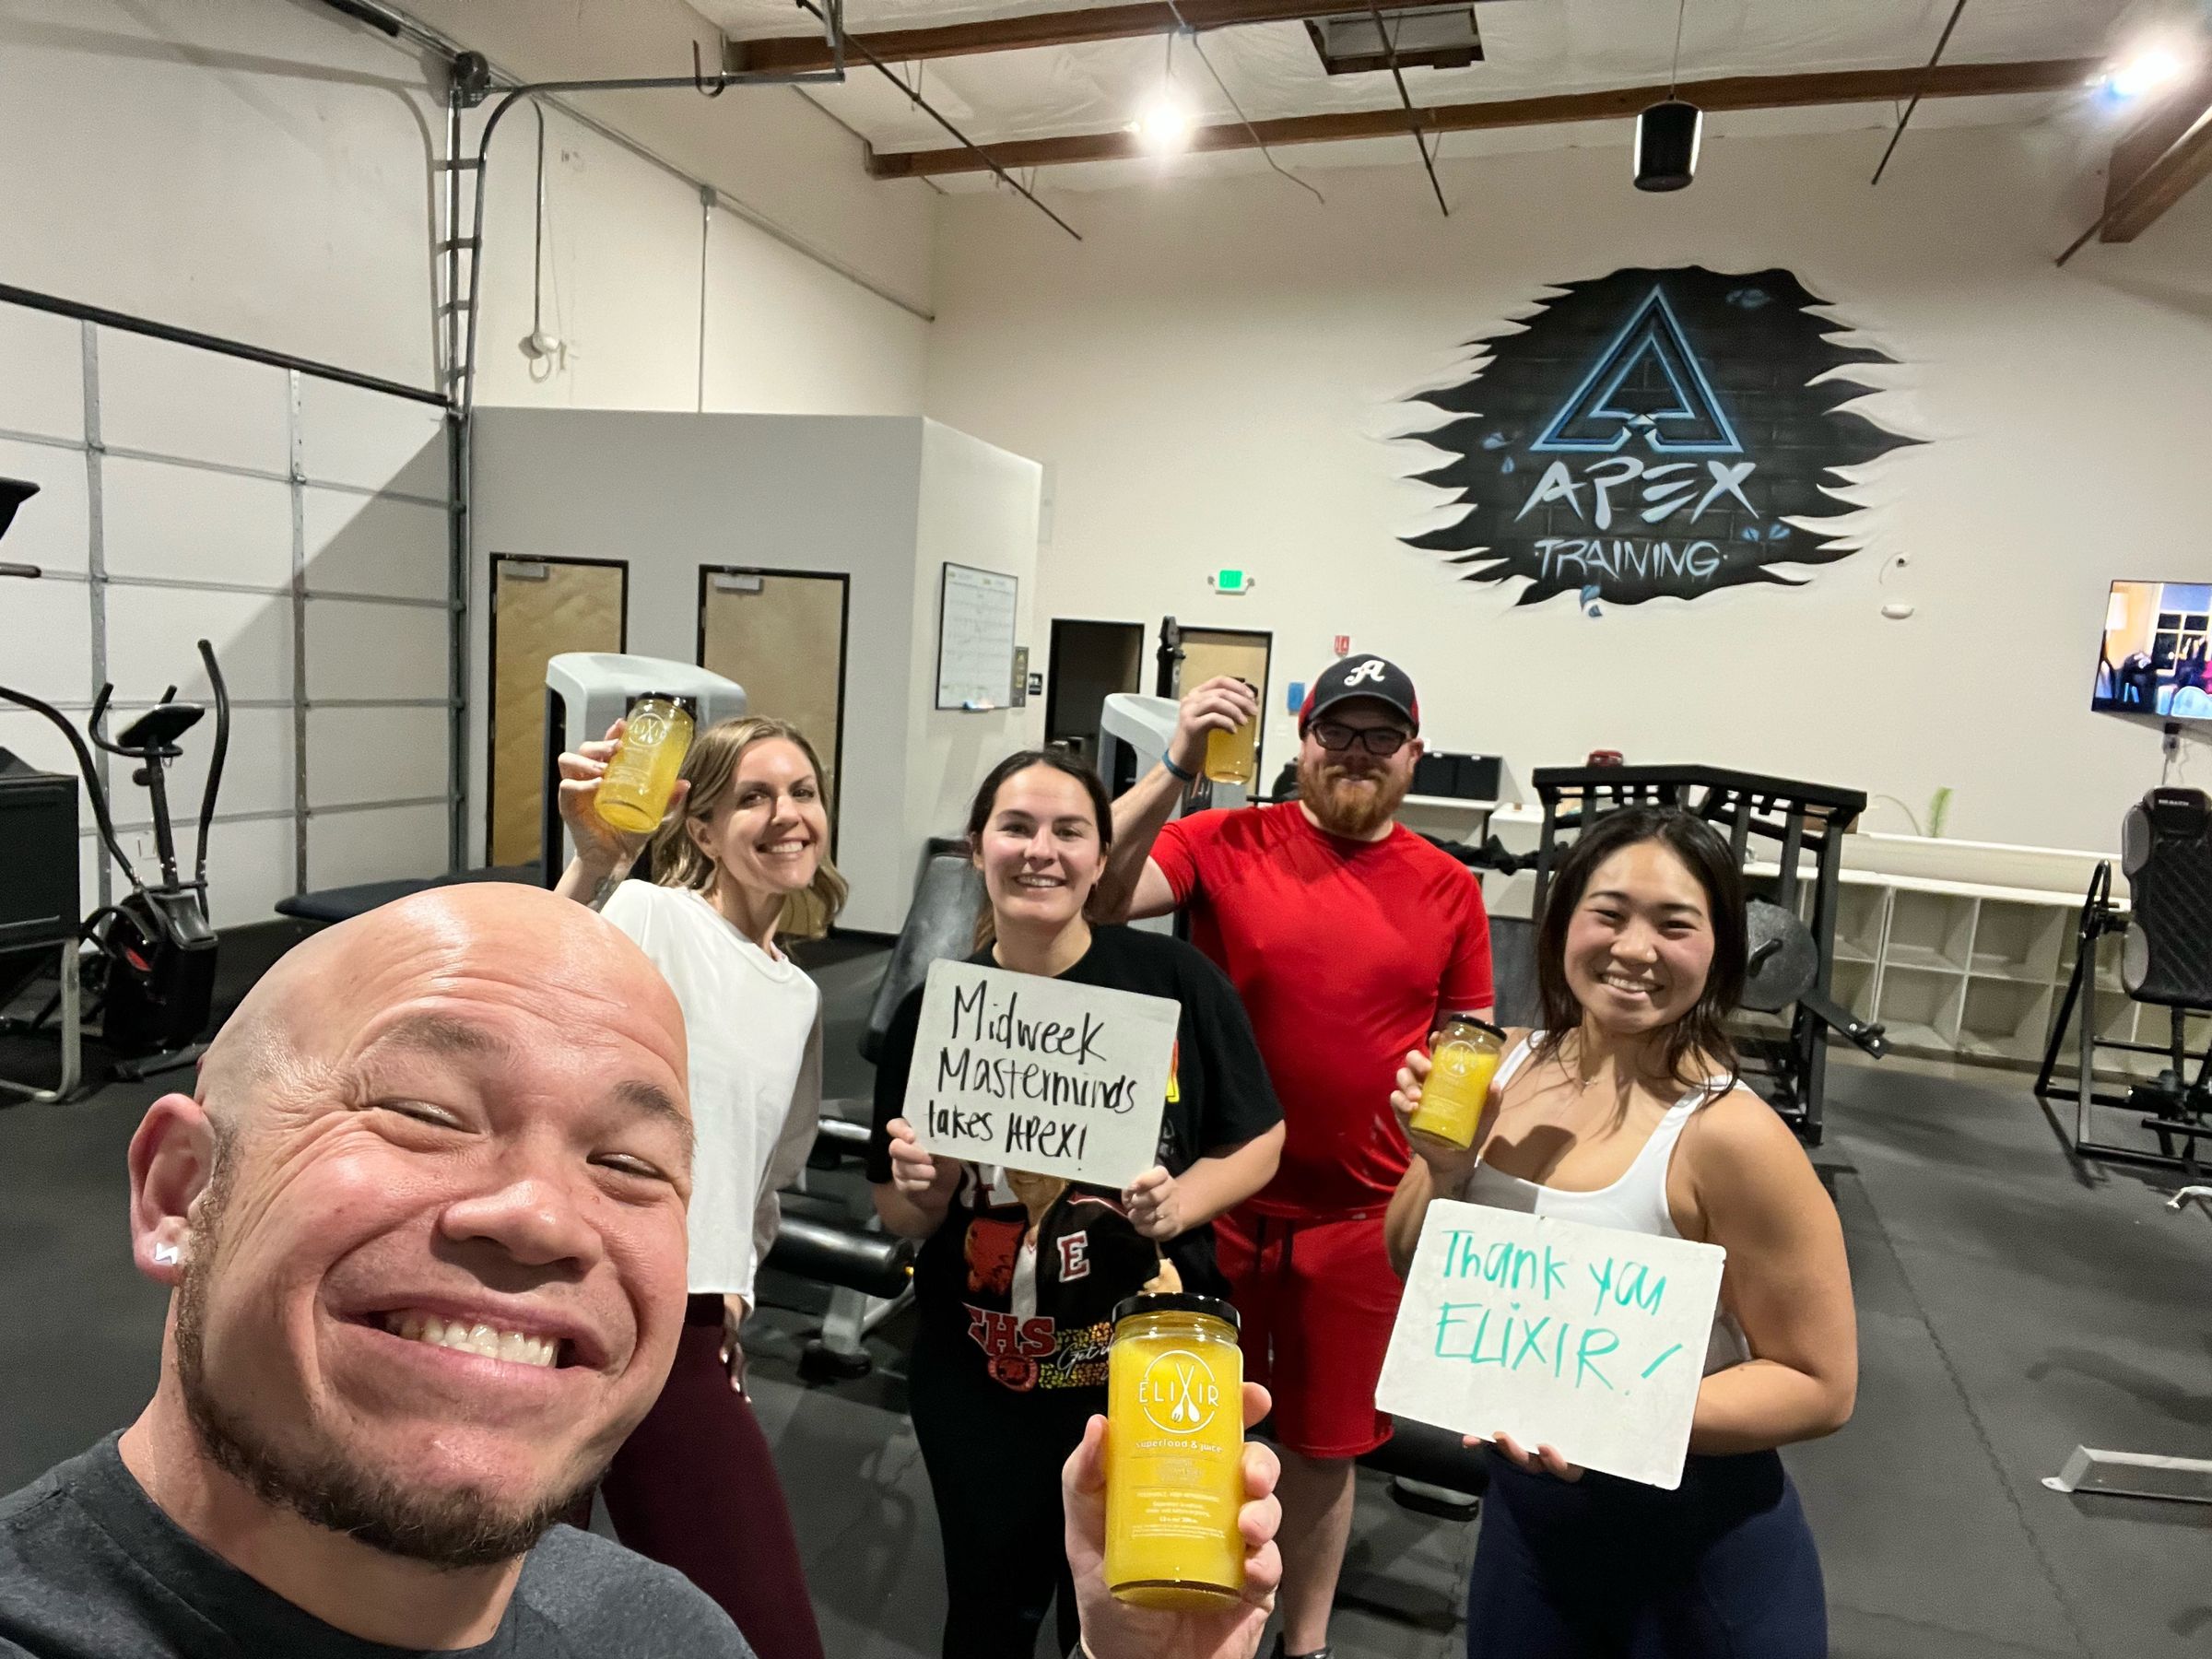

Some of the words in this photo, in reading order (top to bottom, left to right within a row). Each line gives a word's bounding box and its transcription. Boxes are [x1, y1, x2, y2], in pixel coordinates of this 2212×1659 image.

[1515, 456, 1759, 530] APEX
[1536, 539, 1722, 581] TRAINING
[951, 979, 1107, 1065] Midweek
[937, 1047, 1138, 1114] Masterminds
[1056, 1230, 1090, 1283] E
[1441, 1230, 1568, 1300] Thank
[1589, 1257, 1666, 1316] you
[1138, 1362, 1220, 1423] ELIXIR
